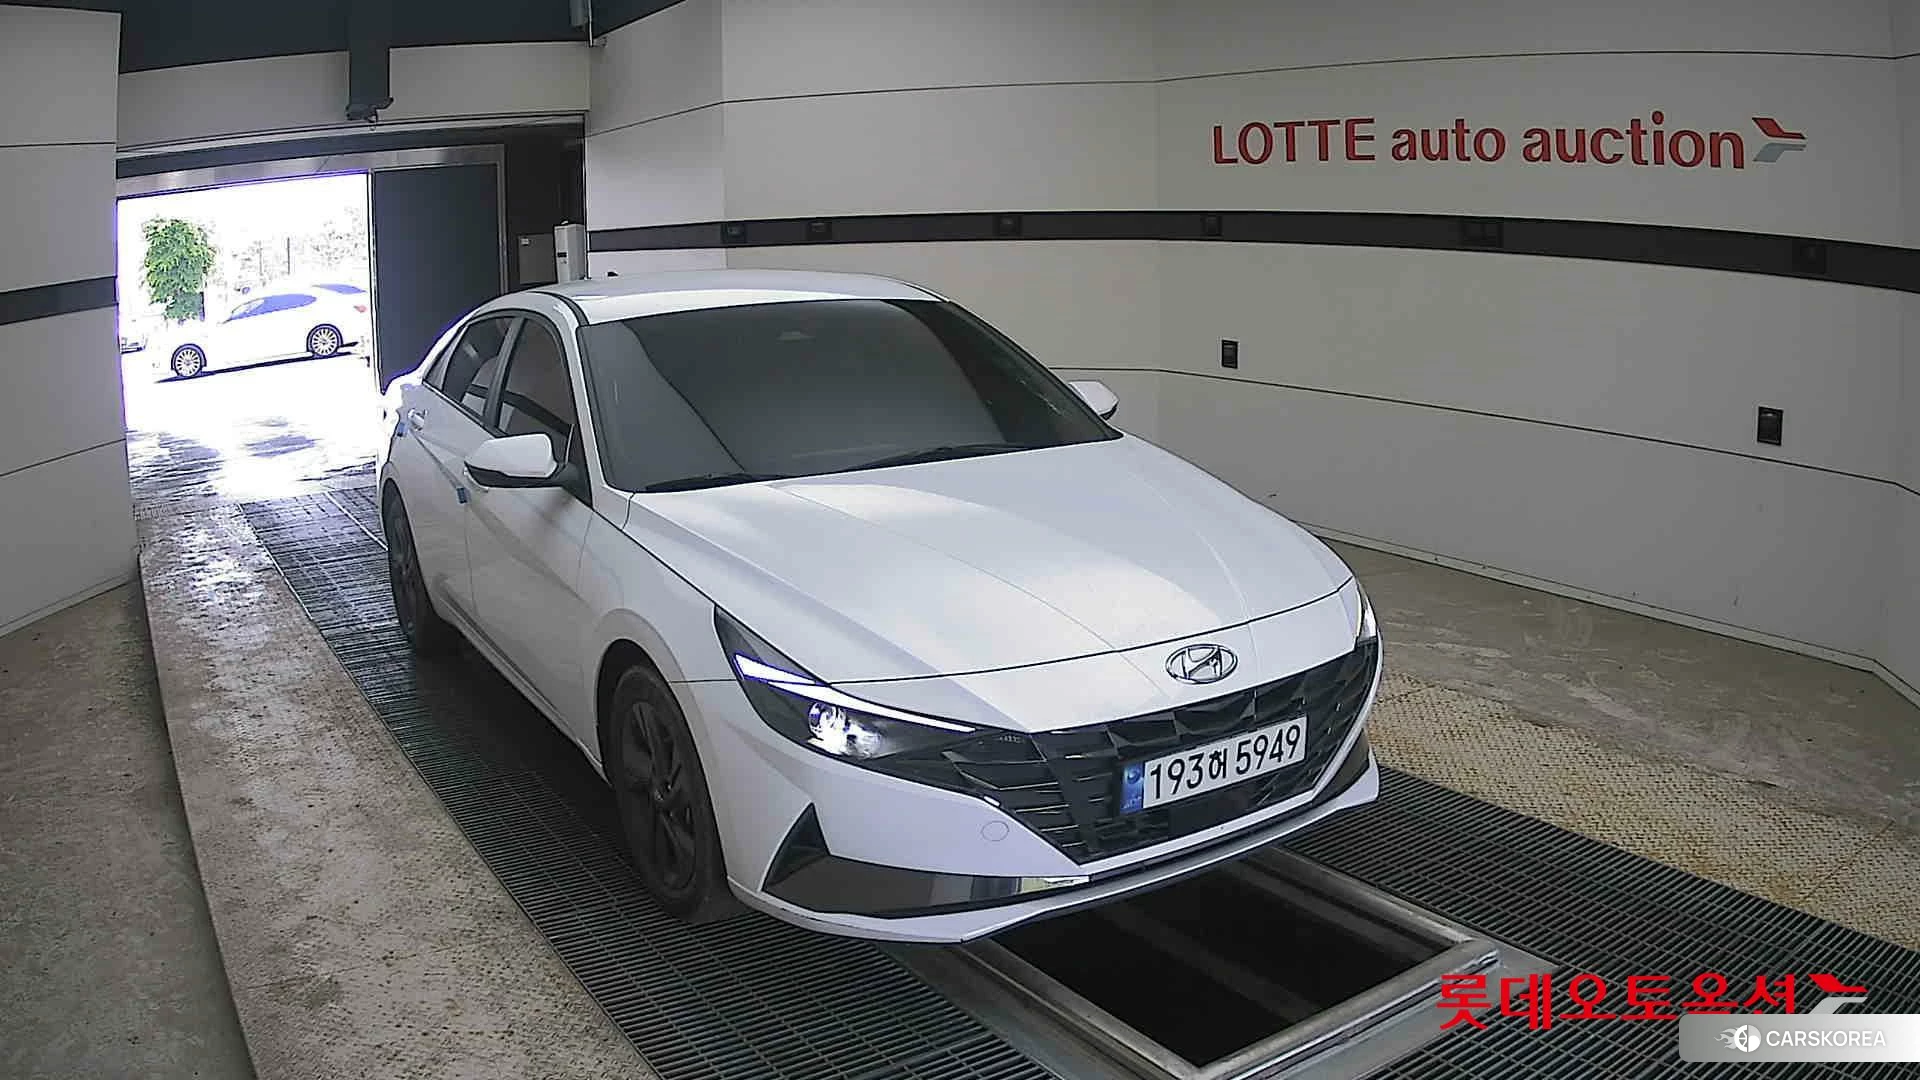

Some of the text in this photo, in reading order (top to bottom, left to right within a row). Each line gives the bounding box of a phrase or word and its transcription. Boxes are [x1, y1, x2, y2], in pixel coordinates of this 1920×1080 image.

[1212, 110, 1745, 170] LOTTE auto auction
[1150, 724, 1301, 800] 193허 5949
